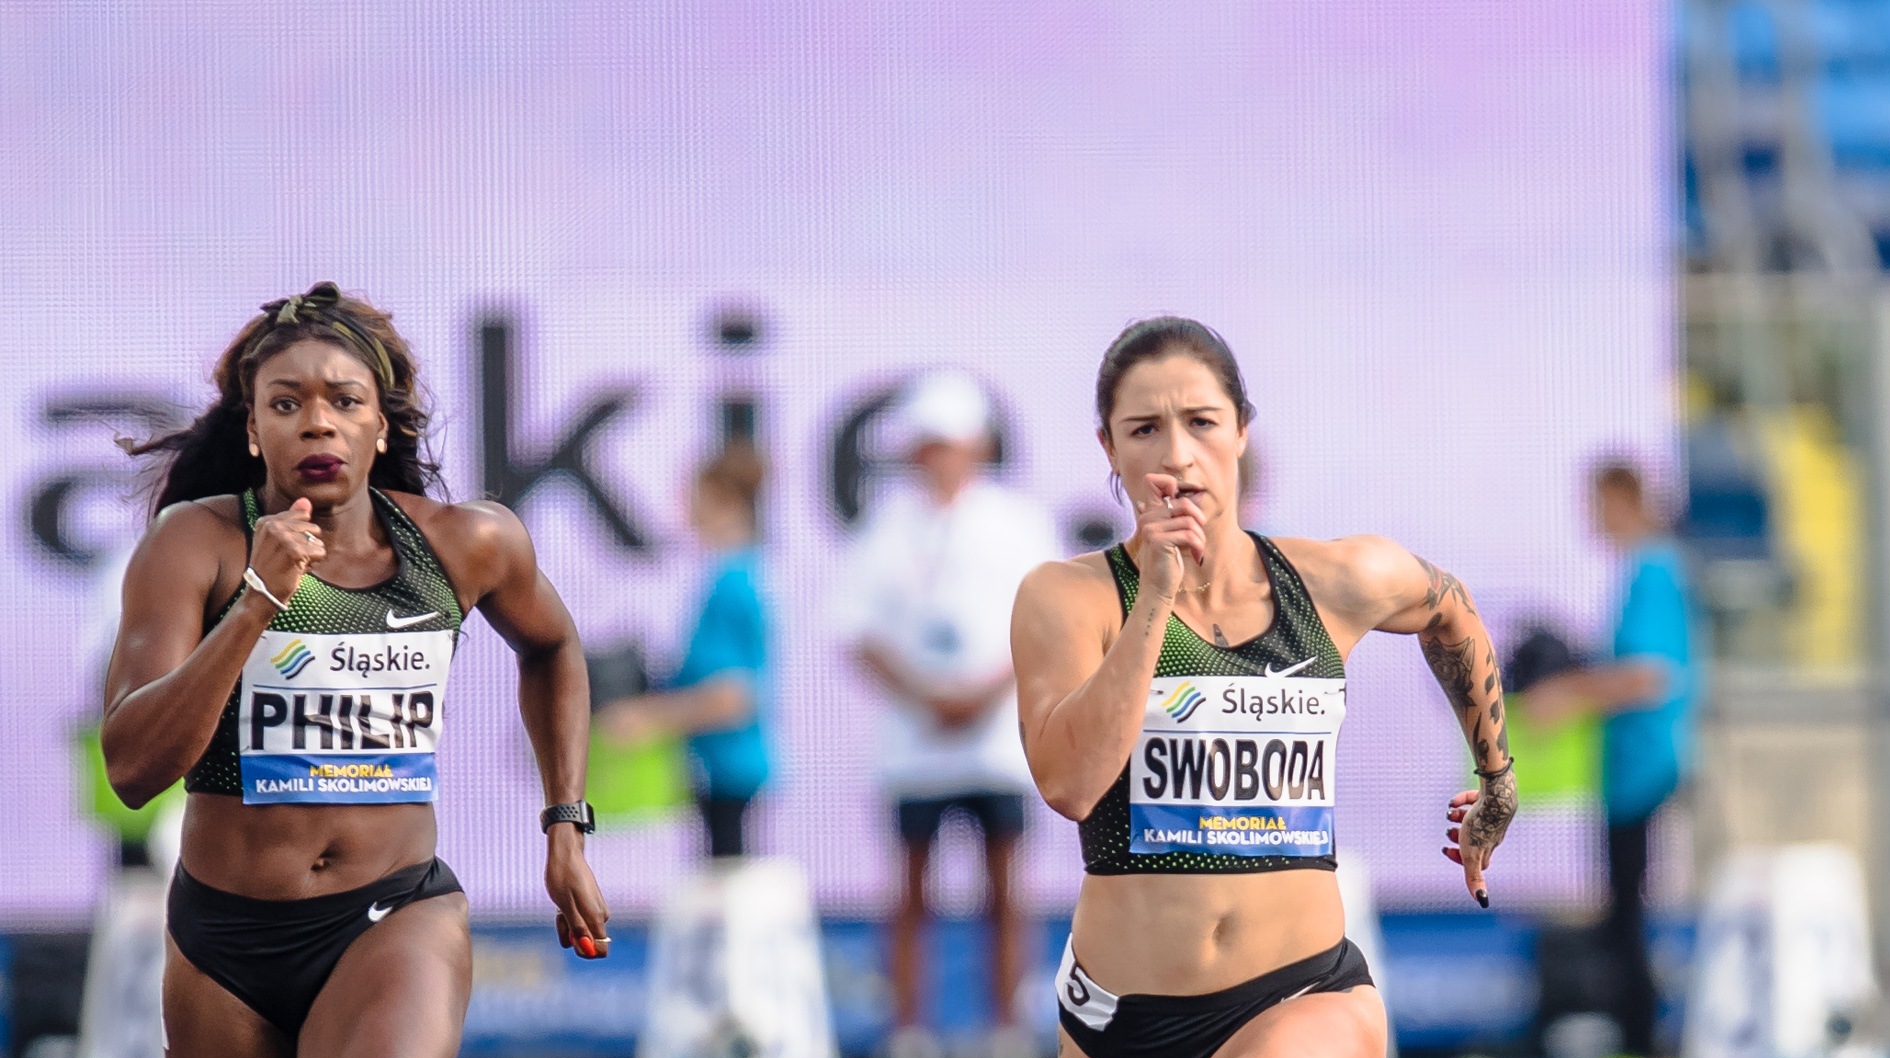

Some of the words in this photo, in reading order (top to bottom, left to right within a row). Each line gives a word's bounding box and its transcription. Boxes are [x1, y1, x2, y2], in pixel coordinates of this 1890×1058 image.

[329, 641, 430, 678] Śląskie.
[1221, 682, 1326, 721] Śląskie.
[251, 690, 434, 750] PHILIP
[309, 763, 394, 777] MEMORIAŁ
[1142, 737, 1326, 801] SWOBODA
[256, 778, 314, 793] KAMILI
[318, 777, 432, 792] SKOLIMOWSKIEJ
[1144, 828, 1203, 844] KAMILI
[1207, 830, 1329, 845] SKOLIMOWSKIEJ
[1199, 816, 1287, 830] MEMORIAŁ
